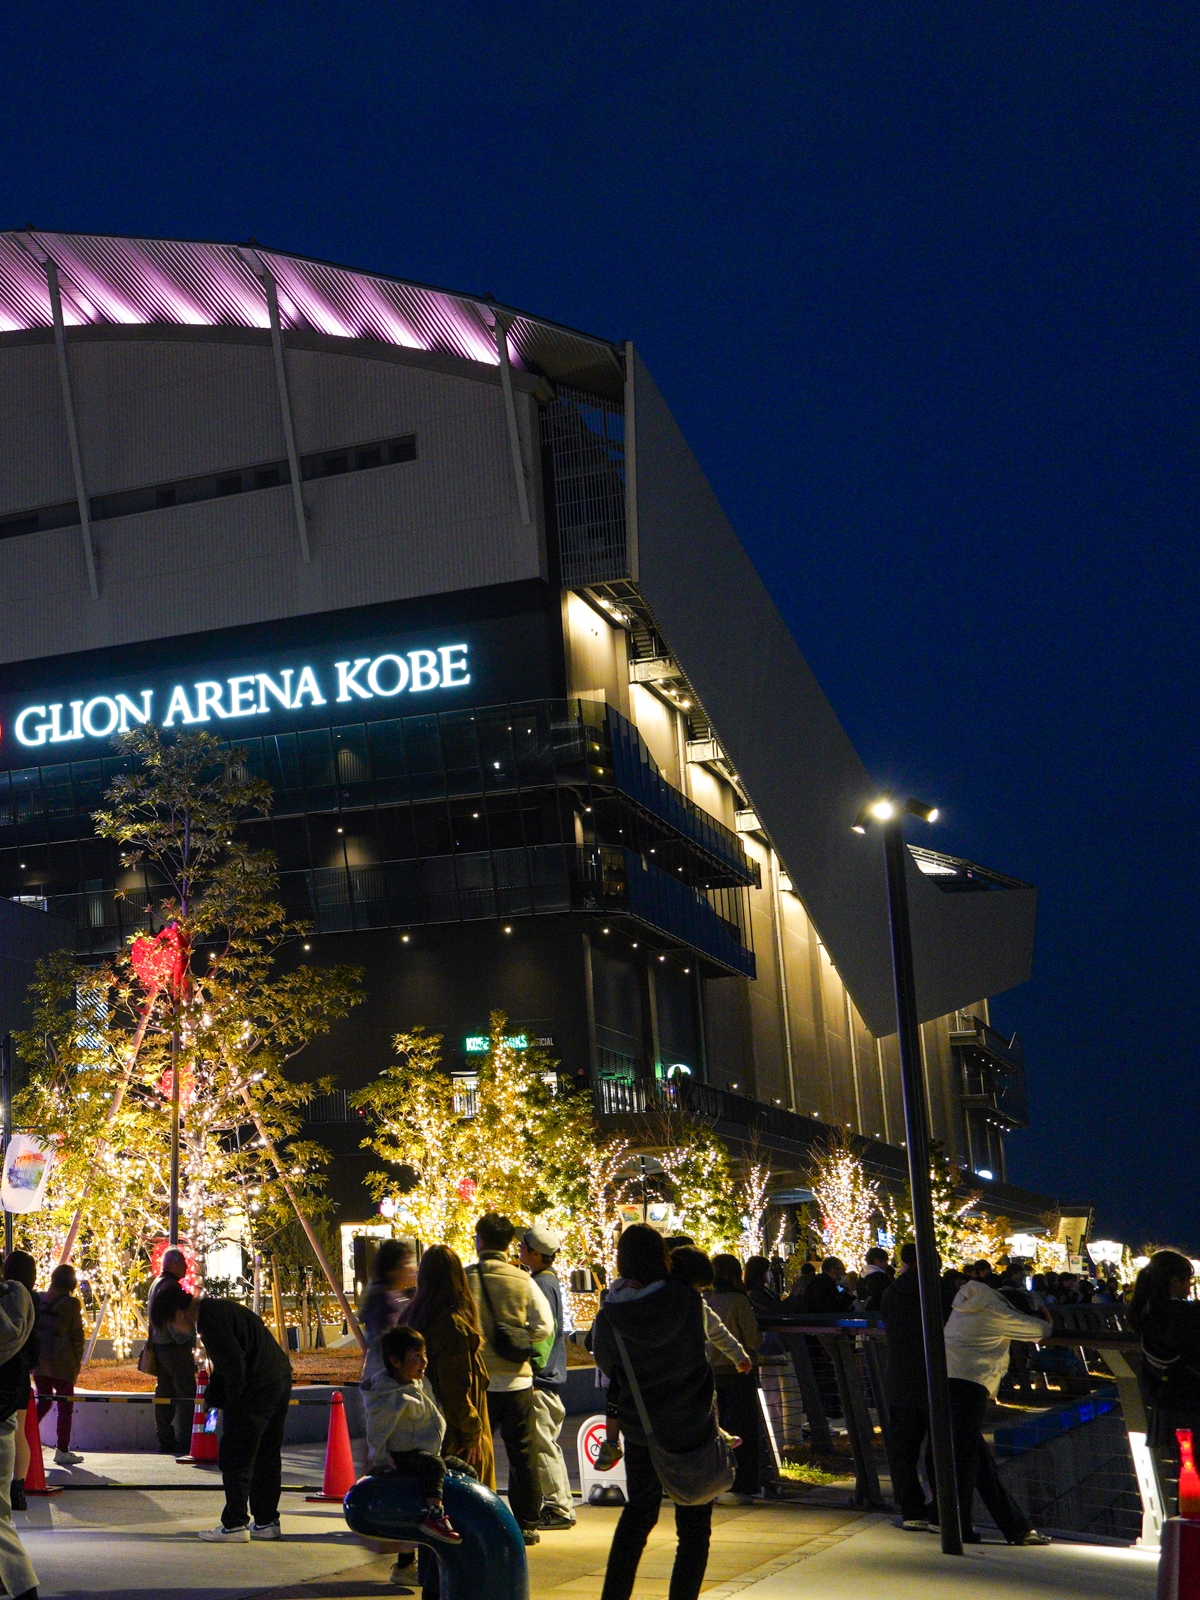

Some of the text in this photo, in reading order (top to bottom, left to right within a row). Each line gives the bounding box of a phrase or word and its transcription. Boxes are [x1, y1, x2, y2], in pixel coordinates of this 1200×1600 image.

[14, 643, 471, 747] GLION ARENA KOBE
